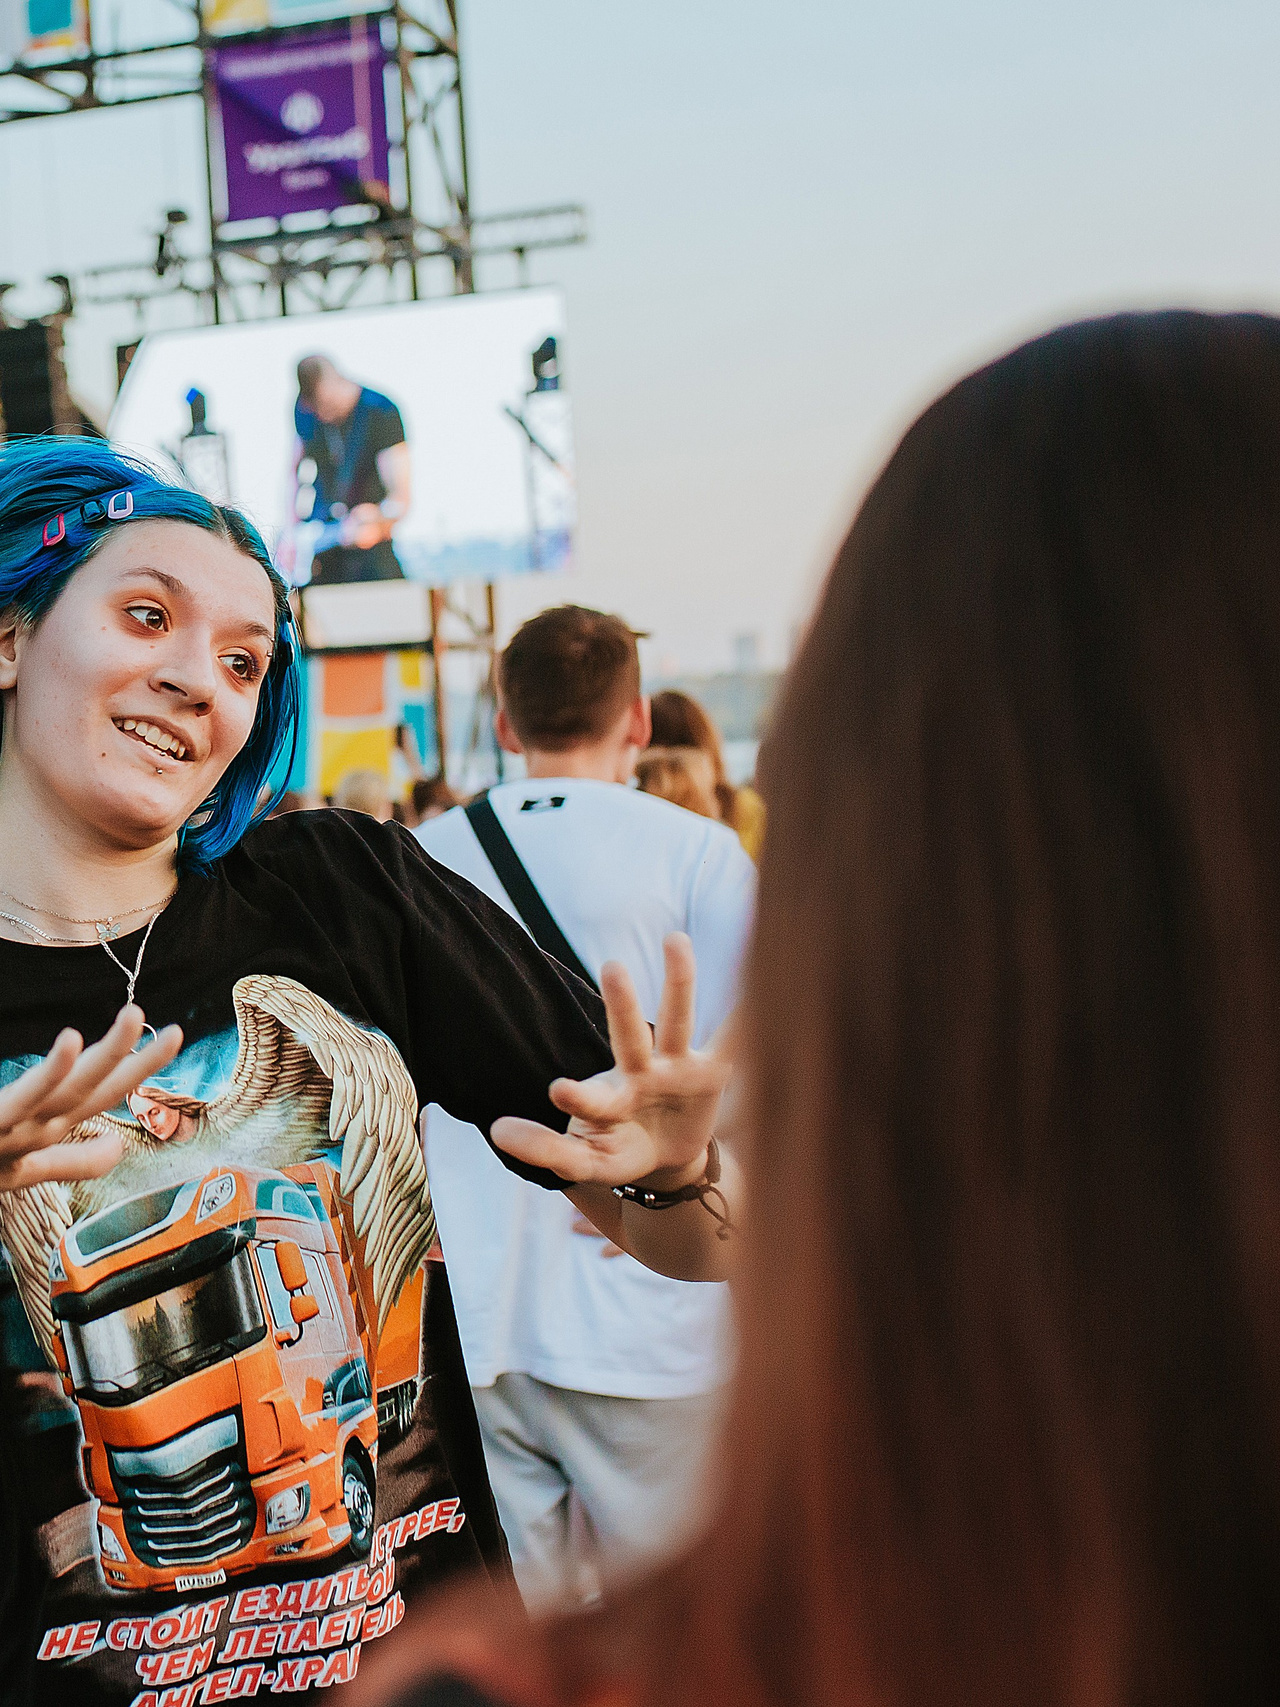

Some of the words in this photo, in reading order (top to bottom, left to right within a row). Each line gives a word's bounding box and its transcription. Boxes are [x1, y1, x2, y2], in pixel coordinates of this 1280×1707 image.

[37, 1620, 101, 1660] НЕ
[106, 1595, 229, 1651] СТОИТ
[230, 1564, 369, 1623] ЕЗДИТЬ
[370, 1497, 466, 1568] СТРЕЕ,
[135, 1637, 216, 1686] ЧЕМ
[217, 1602, 366, 1664] ЛЕТАЕТ
